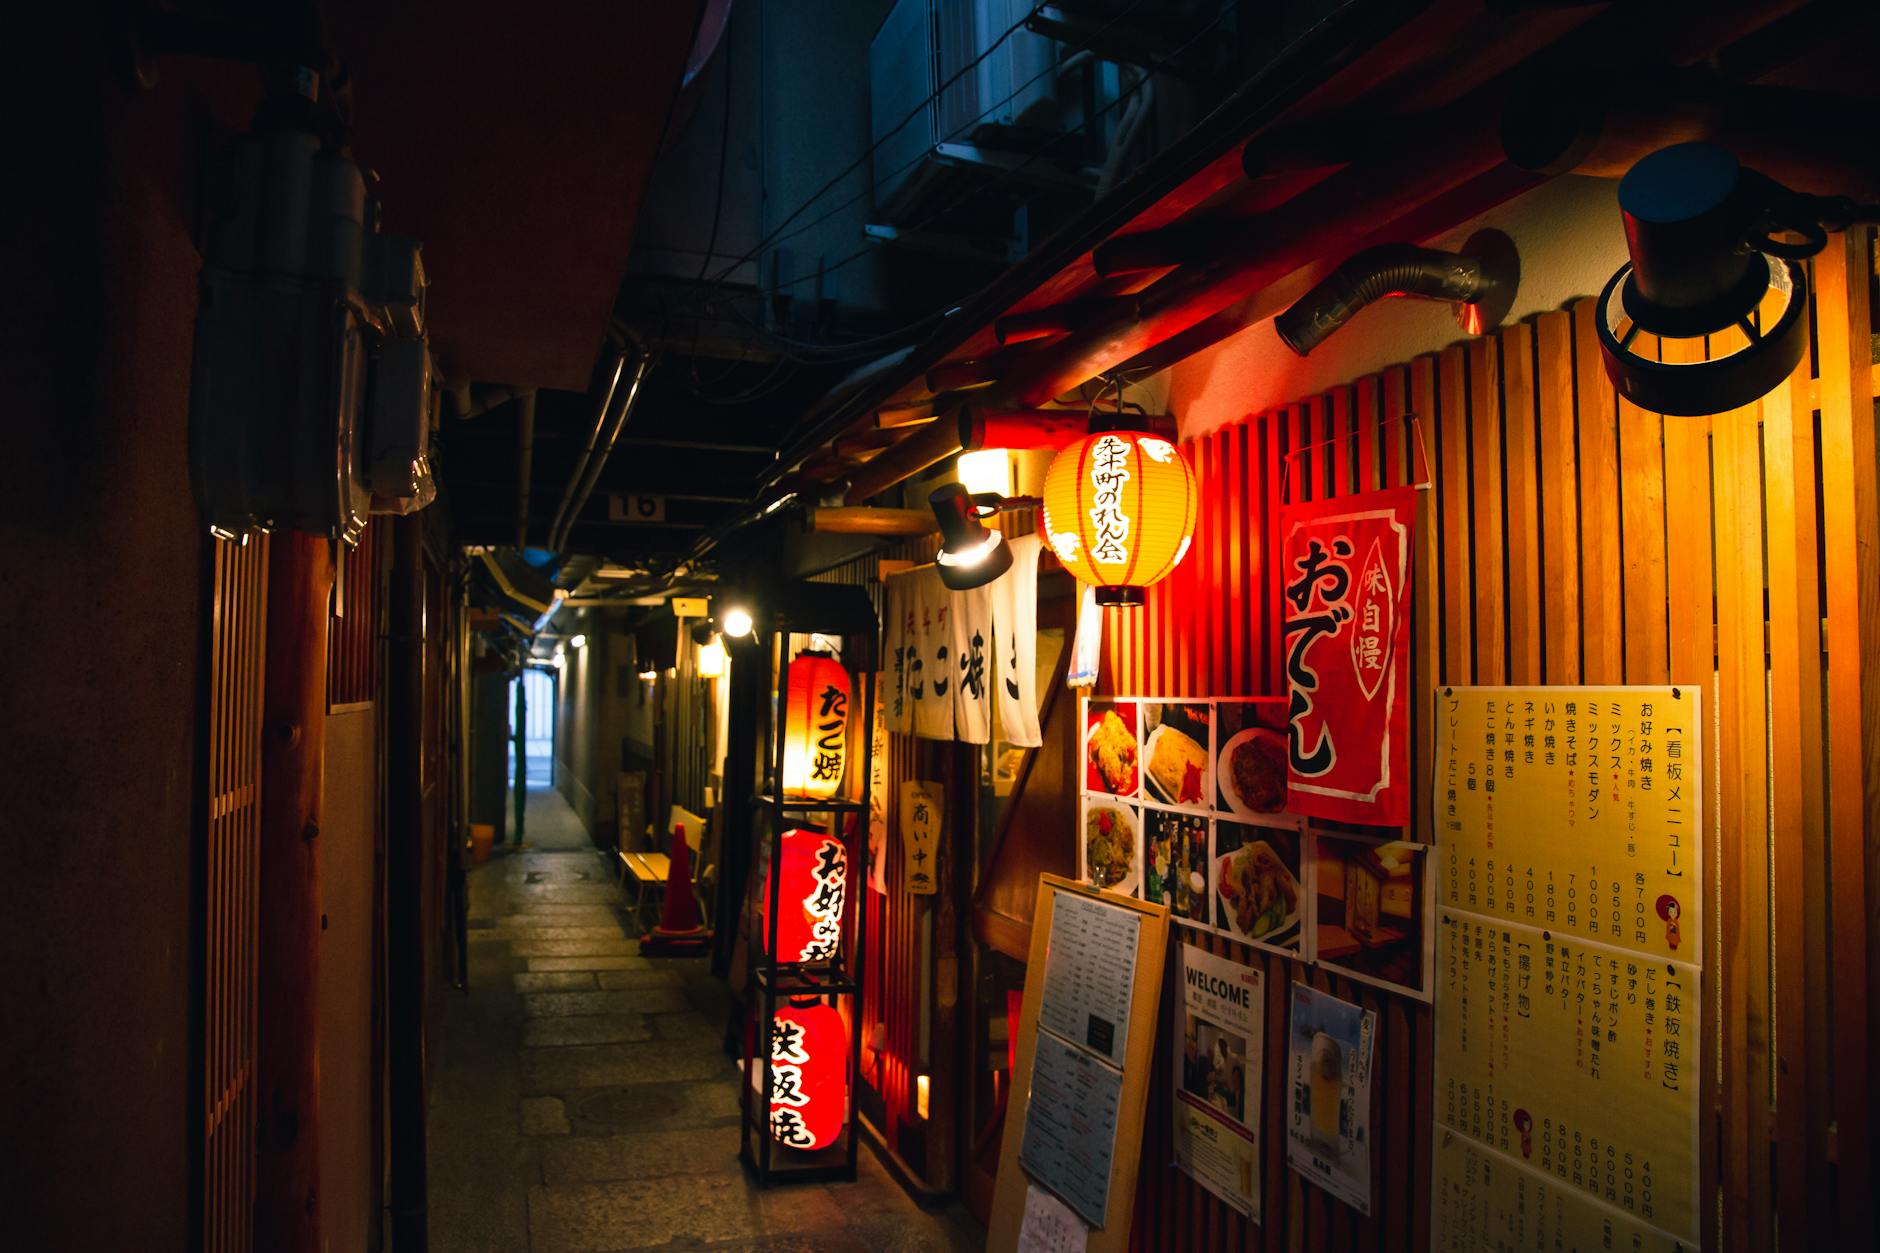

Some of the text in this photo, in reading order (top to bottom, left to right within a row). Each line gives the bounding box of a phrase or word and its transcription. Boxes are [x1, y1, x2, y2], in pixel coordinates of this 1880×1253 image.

[1096, 438, 1126, 561] 先斗町のれん会
[1355, 563, 1387, 670] 味自慢
[1285, 539, 1352, 775] おでん
[812, 685, 848, 781] たこ焼
[1565, 702, 1577, 766] 焼きそば
[1610, 703, 1622, 769] ミックス
[912, 803, 929, 868] 商い中
[1504, 702, 1515, 913] とん平焼き 400円
[1524, 702, 1535, 917] ネギ焼き 400円
[1544, 703, 1555, 922] いか焼き 180円
[1588, 703, 1599, 932] ミックスモダン 1000円
[1635, 703, 1653, 944] お好み焼き 各700円
[1666, 727, 1682, 877] 【看板メニュー】
[1468, 857, 1477, 905] 400円
[1487, 861, 1495, 909] 600円
[1568, 874, 1576, 926] 700円
[1611, 882, 1622, 936] 950円
[1185, 966, 1250, 1009] WELCOME
[1517, 943, 1531, 1019] 【揚げ物】
[1560, 948, 1571, 1010] 帆立バター
[1576, 952, 1586, 1016] イカバター
[1645, 968, 1657, 1025] だし巻き
[1662, 982, 1682, 1092] 【鉄板焼き】
[1487, 1084, 1496, 1145] 1000円
[1605, 959, 1620, 1201] 牛すじポン酢 600円
[1623, 963, 1637, 1210] 砂ずり 500円
[1589, 1138, 1599, 1193] 600円
[1642, 1161, 1653, 1218] 400円
